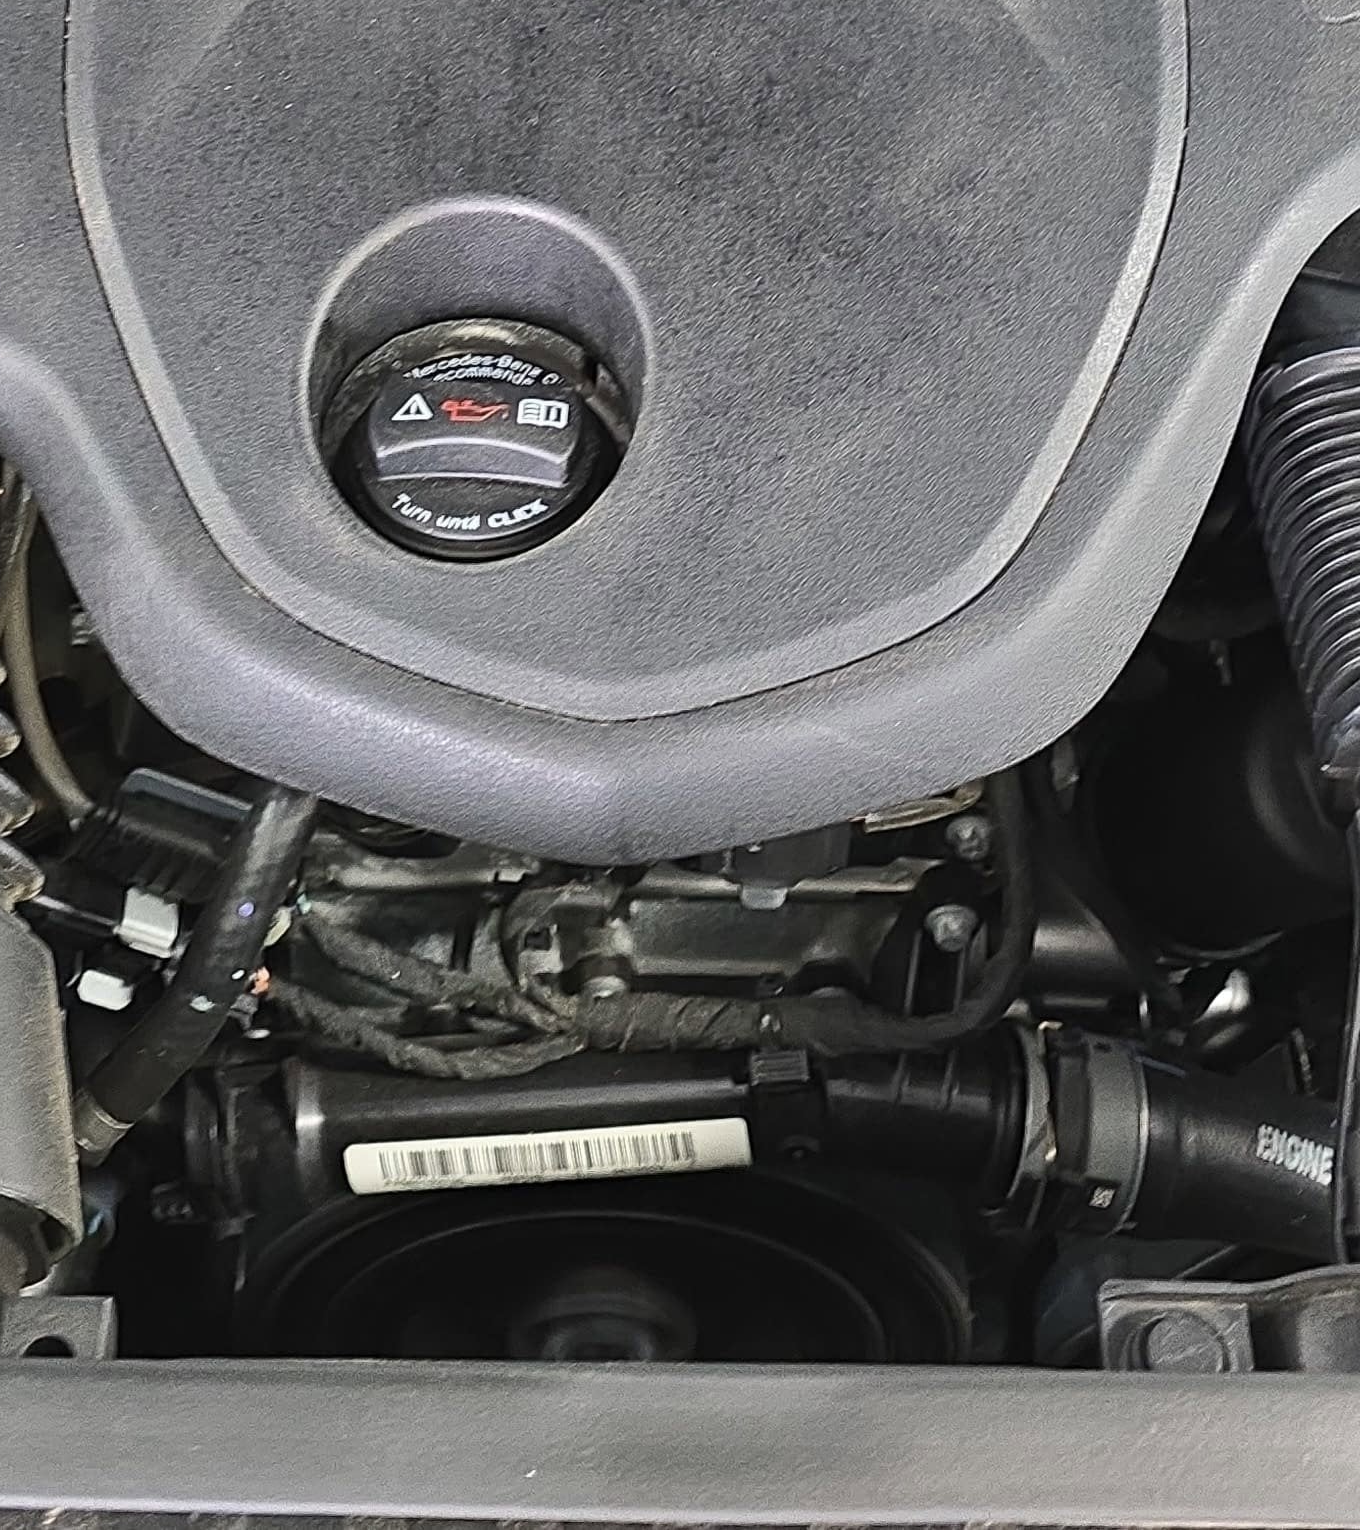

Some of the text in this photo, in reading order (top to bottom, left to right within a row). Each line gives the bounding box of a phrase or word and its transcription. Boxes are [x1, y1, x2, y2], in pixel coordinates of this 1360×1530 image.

[391, 492, 549, 531] Turn until CLICK
[1255, 1123, 1335, 1186] ENGINE
